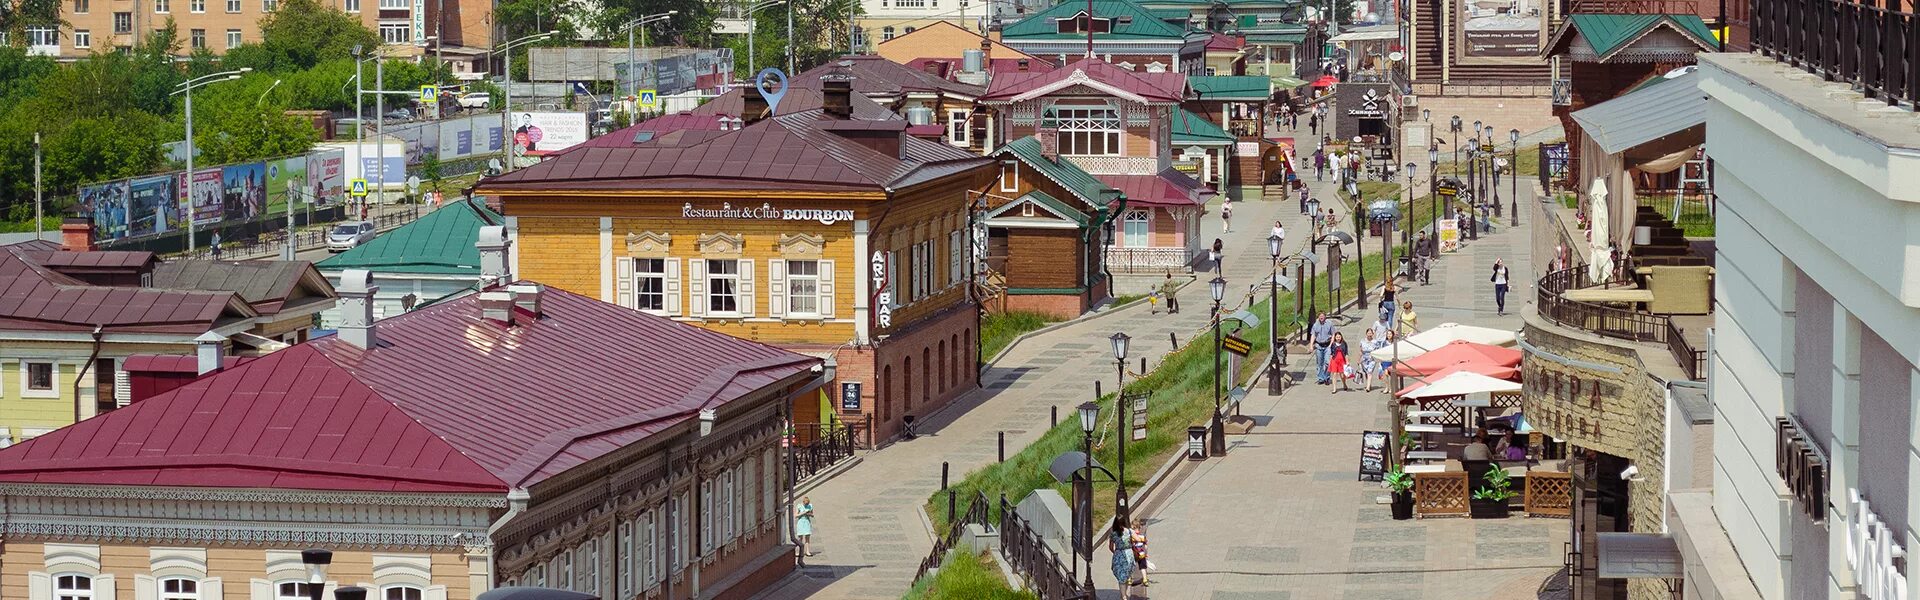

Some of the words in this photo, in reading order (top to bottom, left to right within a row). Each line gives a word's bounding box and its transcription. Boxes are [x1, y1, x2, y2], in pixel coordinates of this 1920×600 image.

[783, 209, 854, 225] BOURBON
[872, 250, 884, 289] ART
[879, 293, 891, 328] BAR
